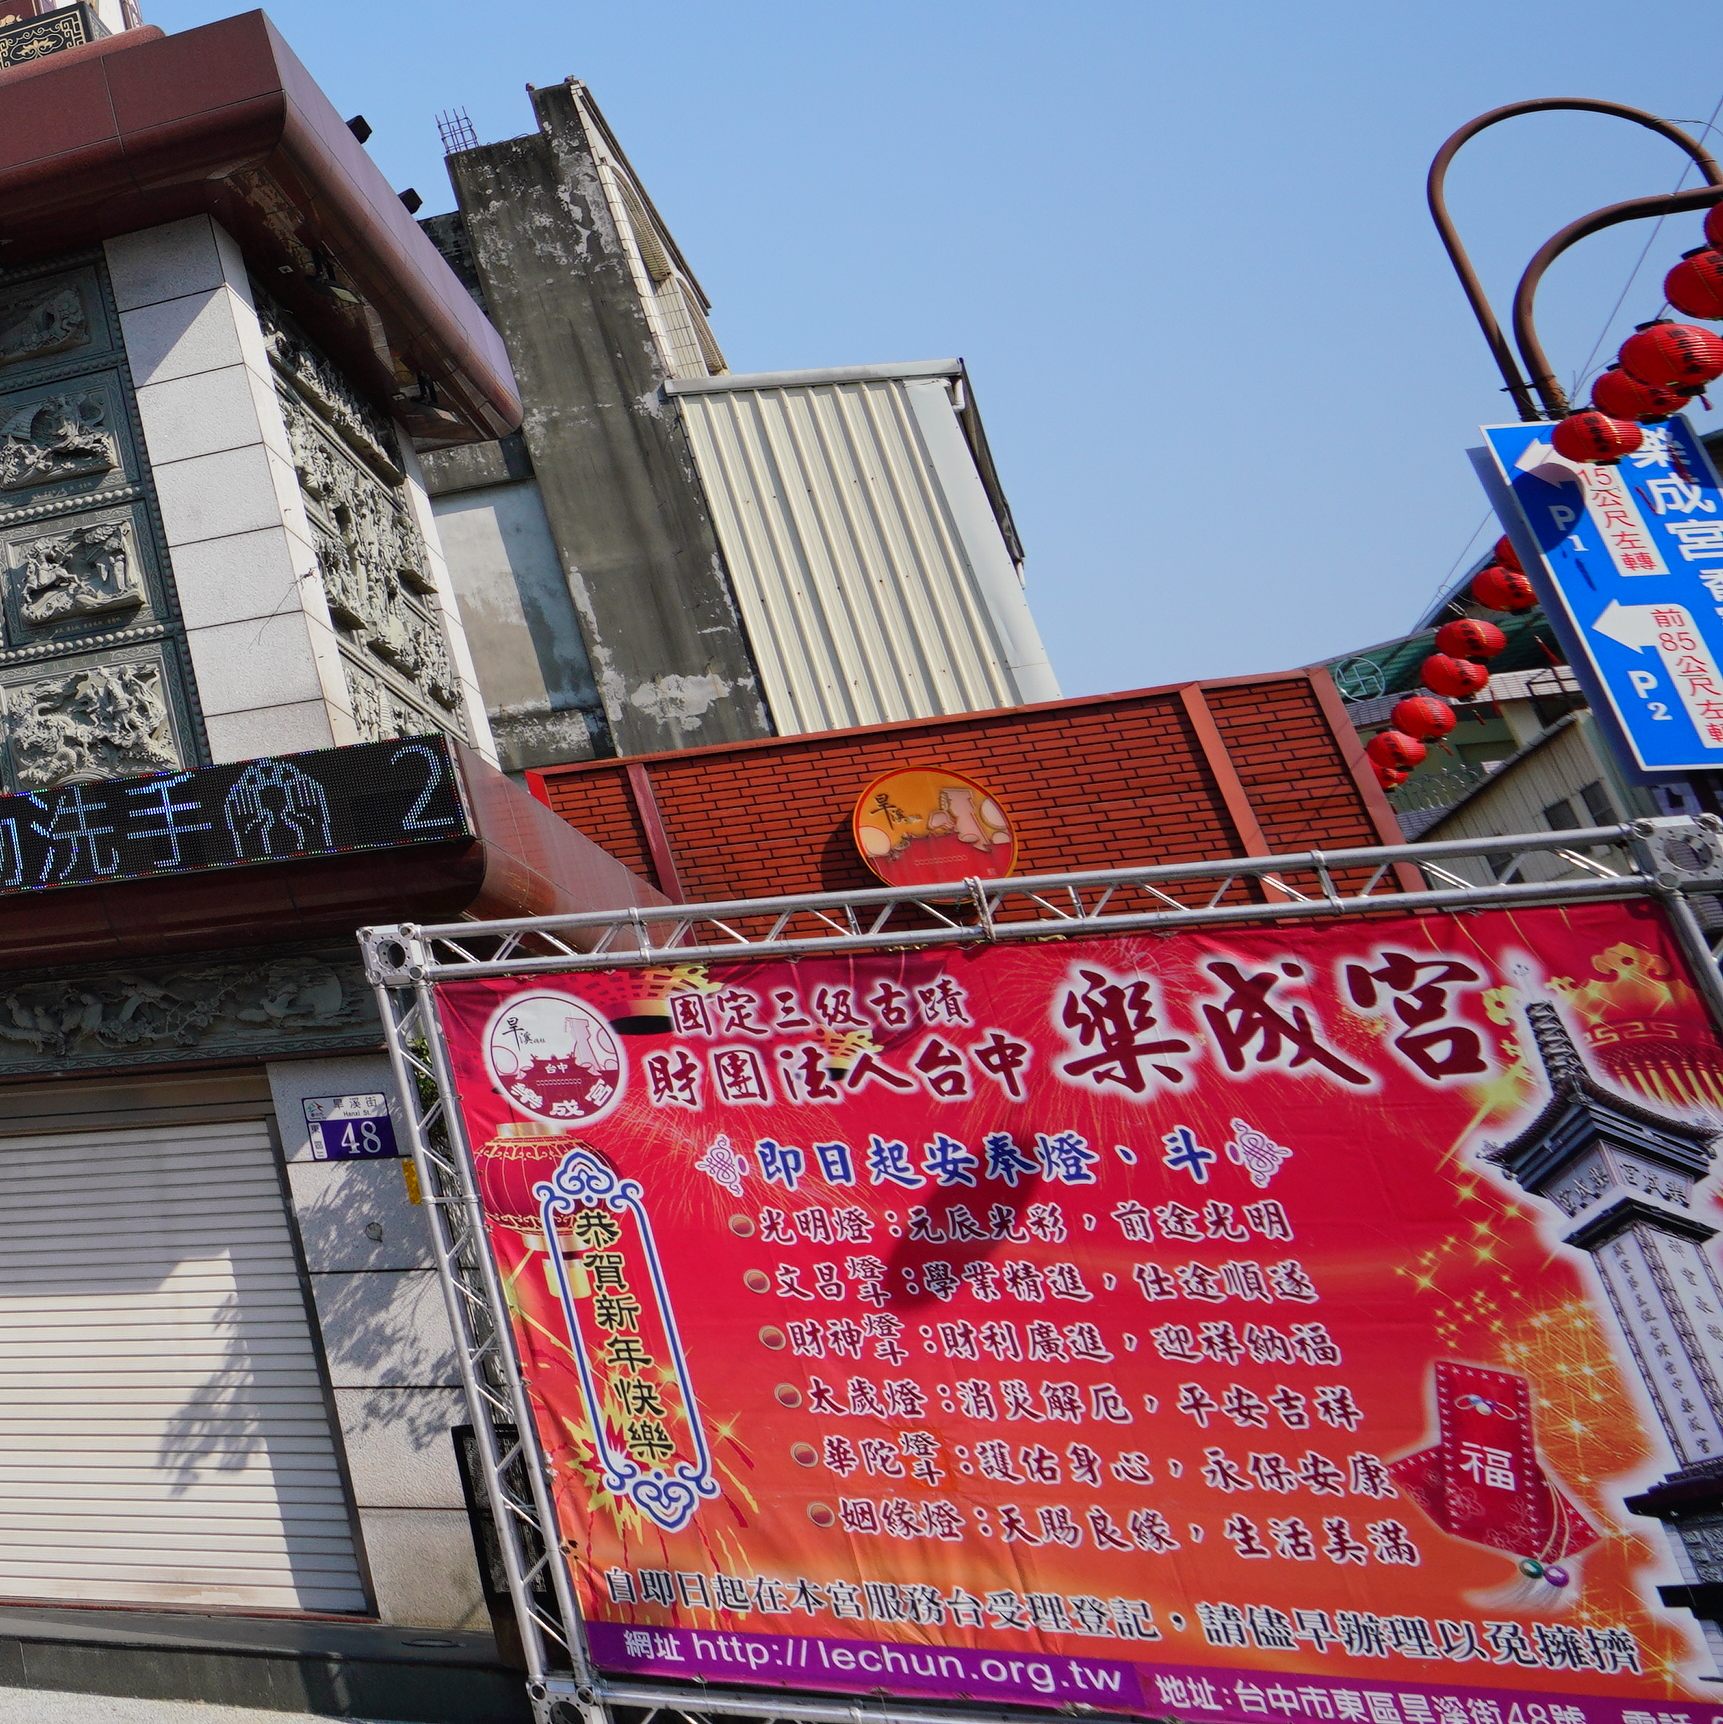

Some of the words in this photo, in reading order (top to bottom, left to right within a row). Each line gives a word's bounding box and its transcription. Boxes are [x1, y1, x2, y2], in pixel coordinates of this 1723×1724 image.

[671, 978, 970, 1036] 國定三級古蹟
[1063, 952, 1488, 1094] 樂成宮
[648, 1033, 1028, 1108] 財團法人台中
[341, 1121, 382, 1154] 48
[575, 1211, 676, 1462] 恭賀新年快樂
[1460, 1441, 1515, 1492] 福
[624, 1629, 685, 1664] 網址
